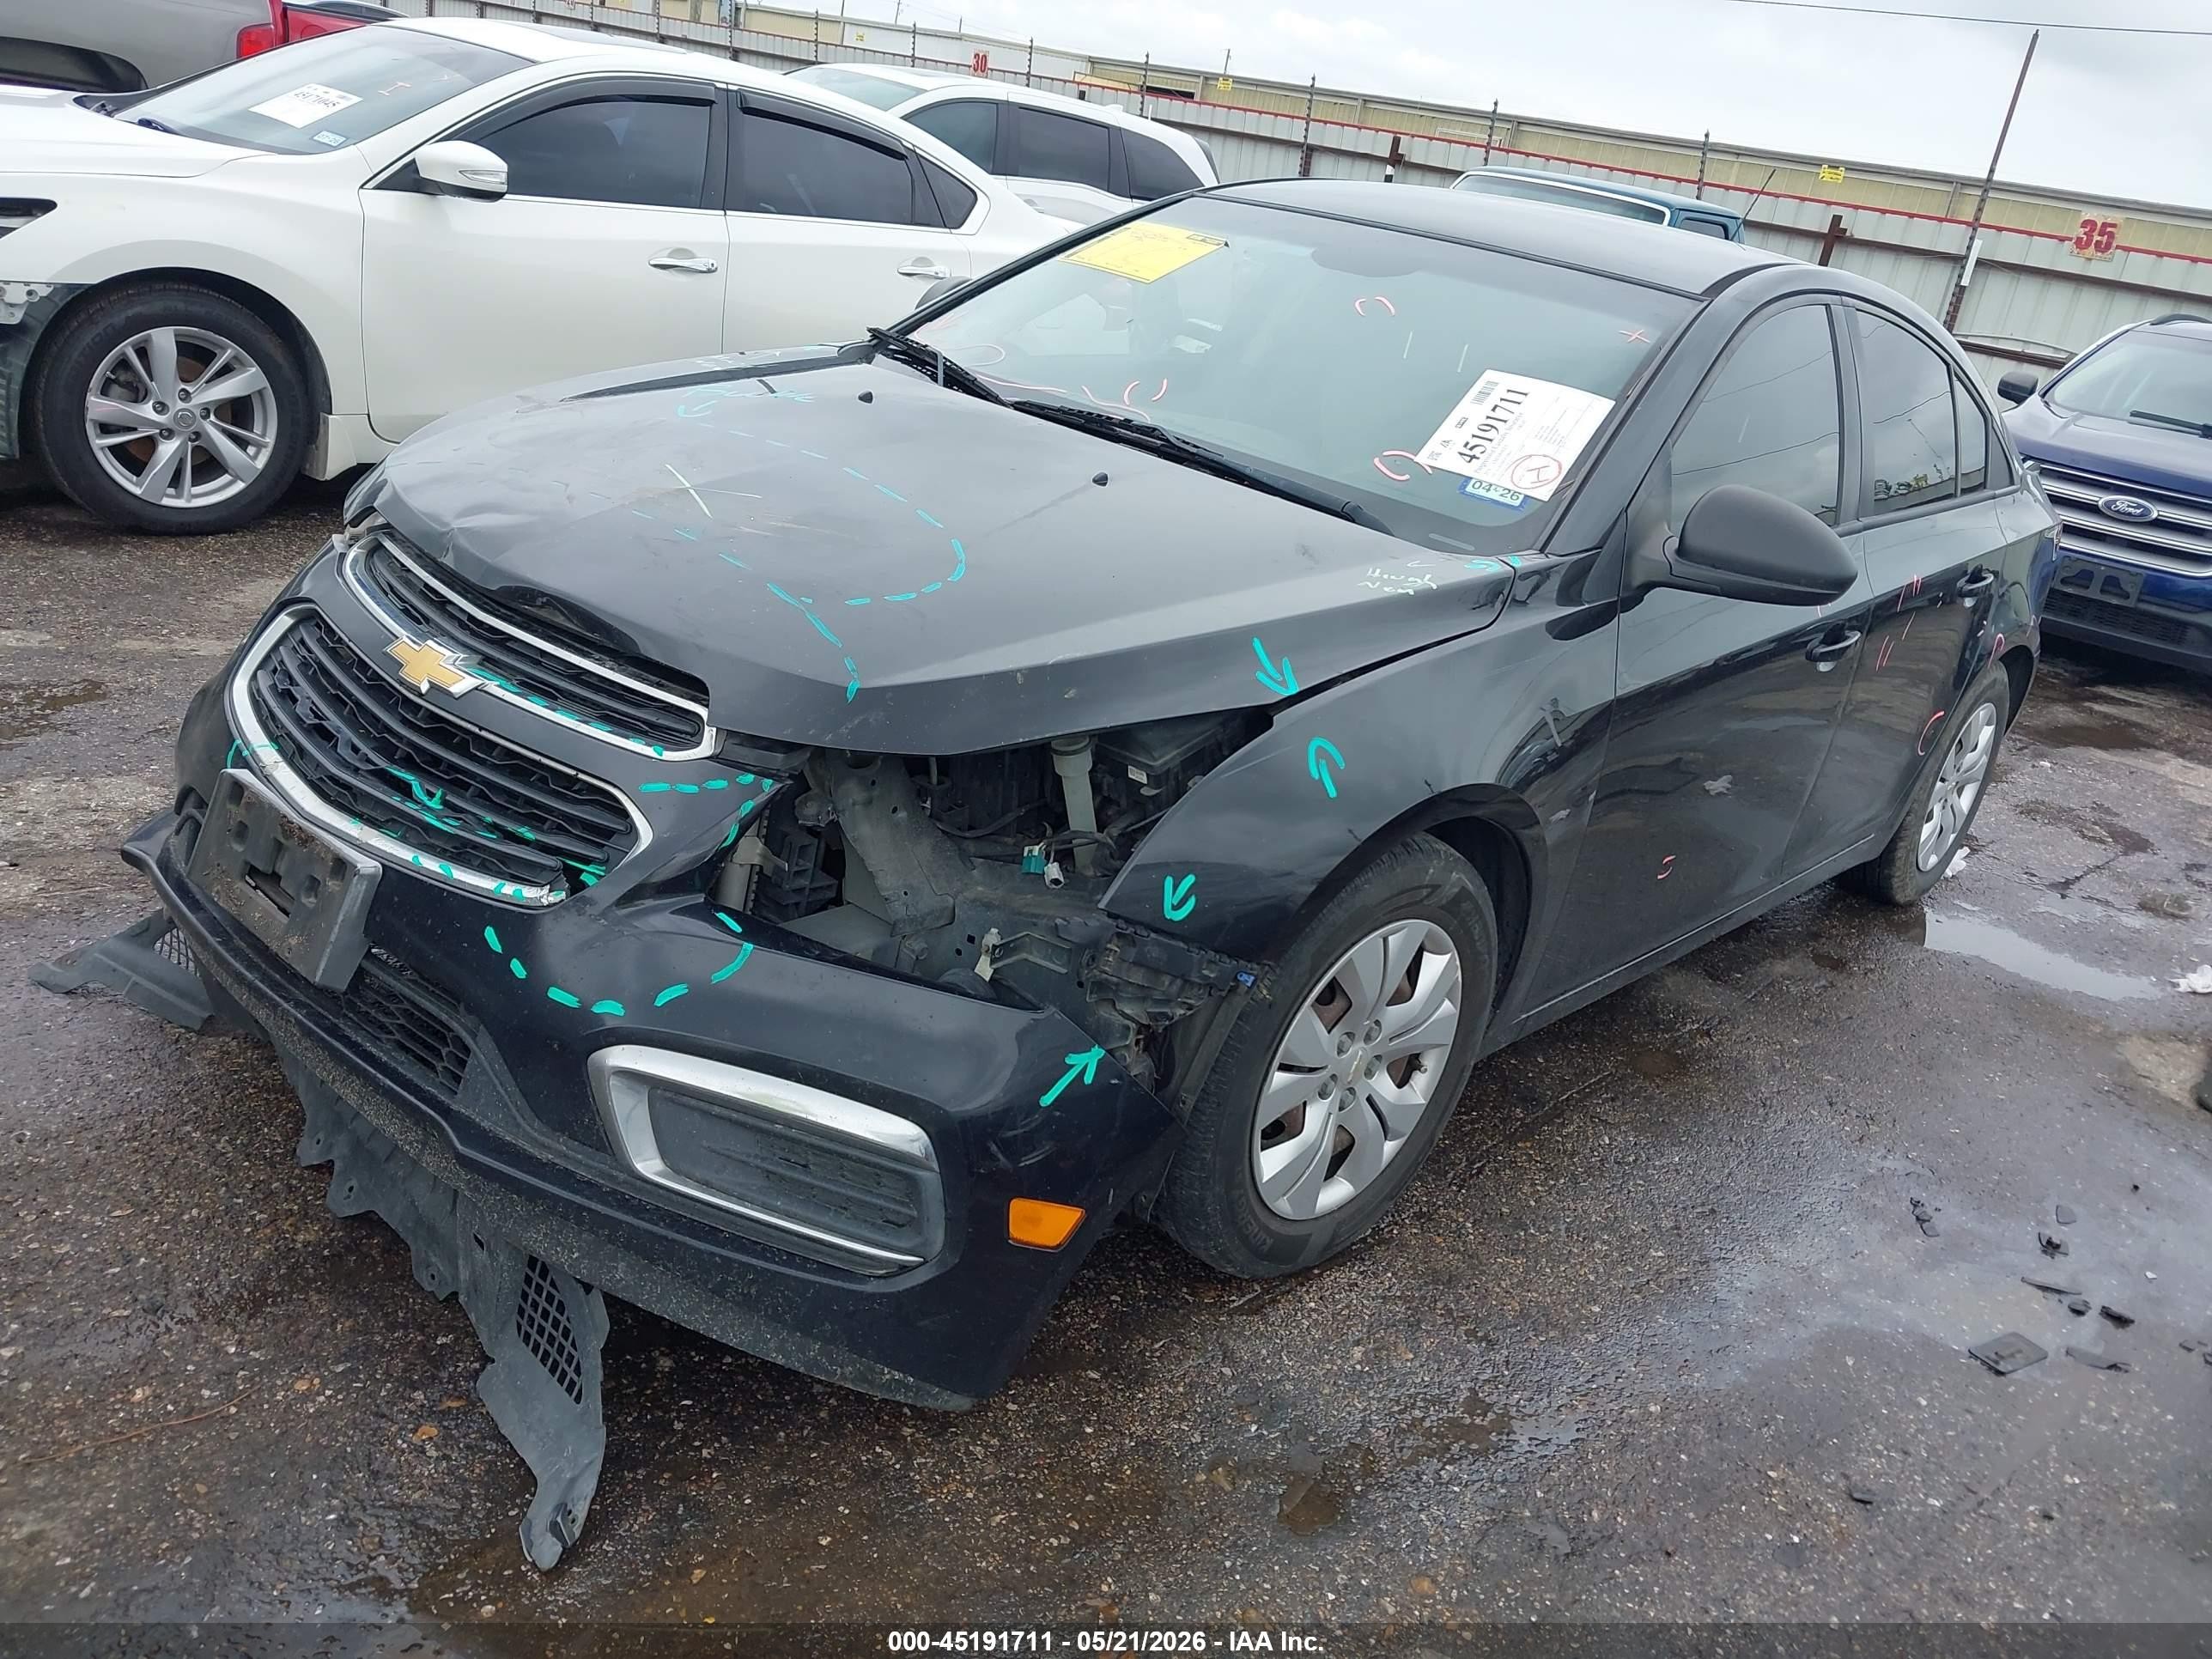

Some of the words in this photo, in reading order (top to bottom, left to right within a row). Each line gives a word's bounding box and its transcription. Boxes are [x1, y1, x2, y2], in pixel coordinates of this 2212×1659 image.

[973, 52, 988, 74] 30
[2074, 218, 2118, 253] 35
[1457, 388, 1530, 465] 45191711
[2110, 499, 2145, 517] Ford
